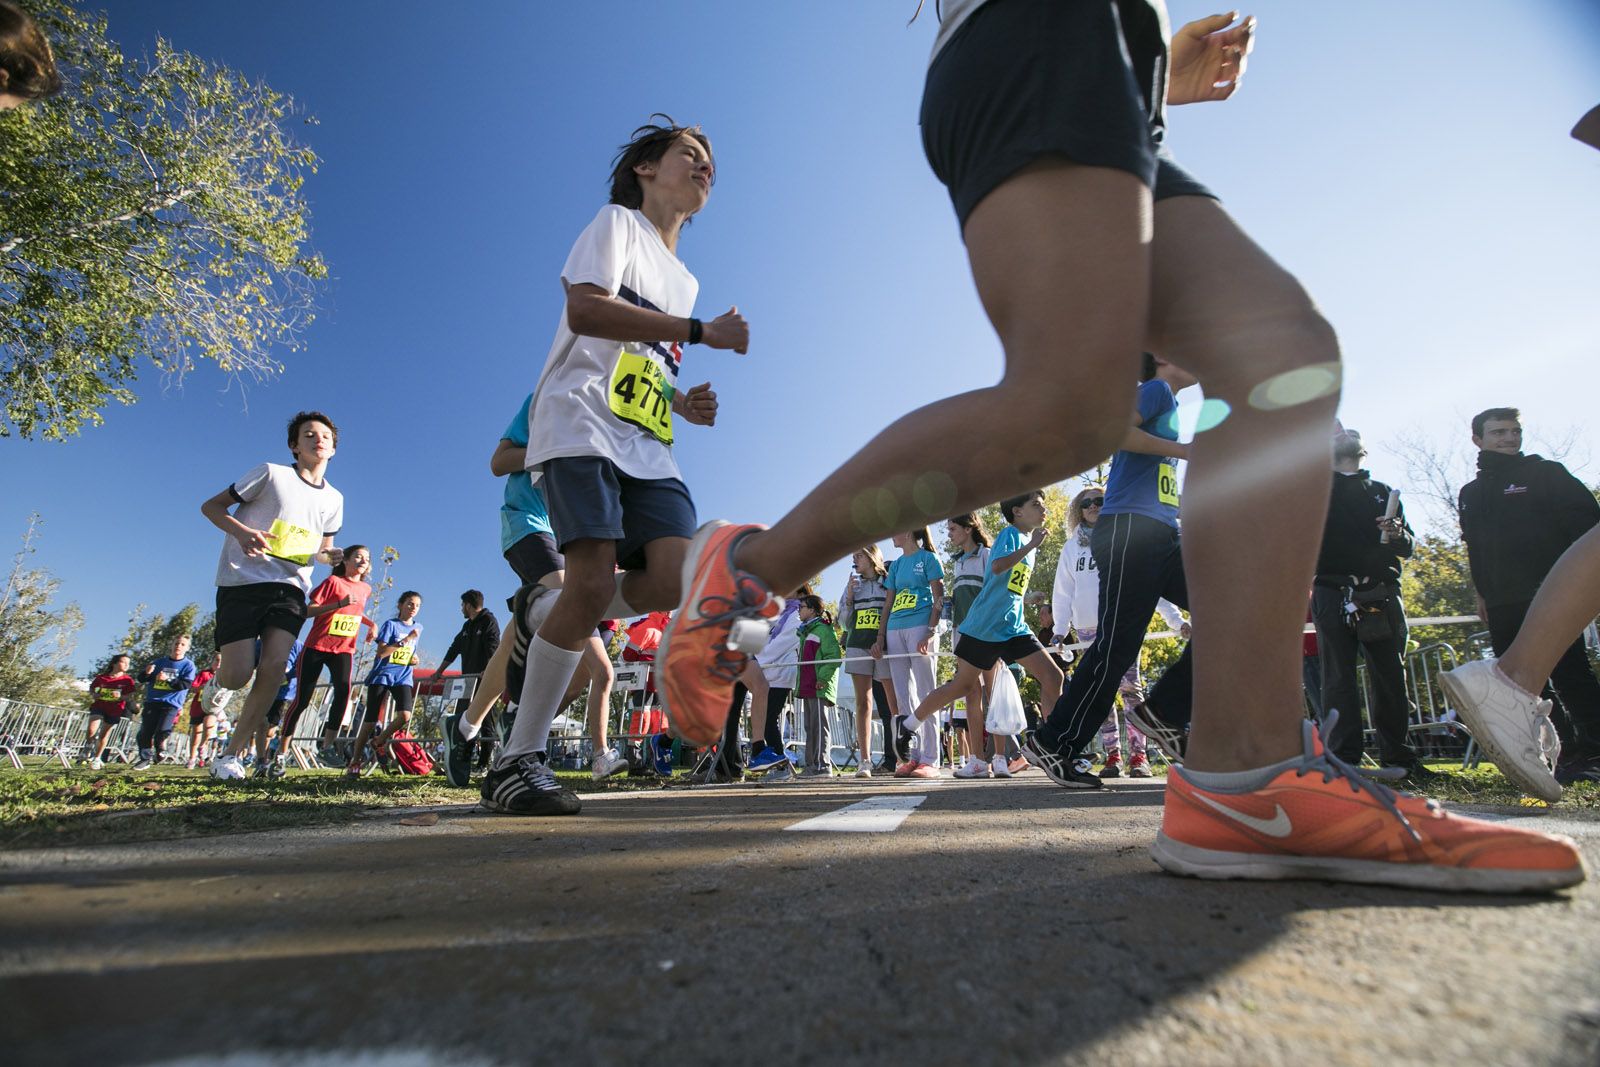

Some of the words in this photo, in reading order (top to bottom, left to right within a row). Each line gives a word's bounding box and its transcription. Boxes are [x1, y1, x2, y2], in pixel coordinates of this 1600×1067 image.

[614, 373, 669, 429] 4772
[1075, 557, 1086, 572] 19
[1010, 569, 1029, 588] 28
